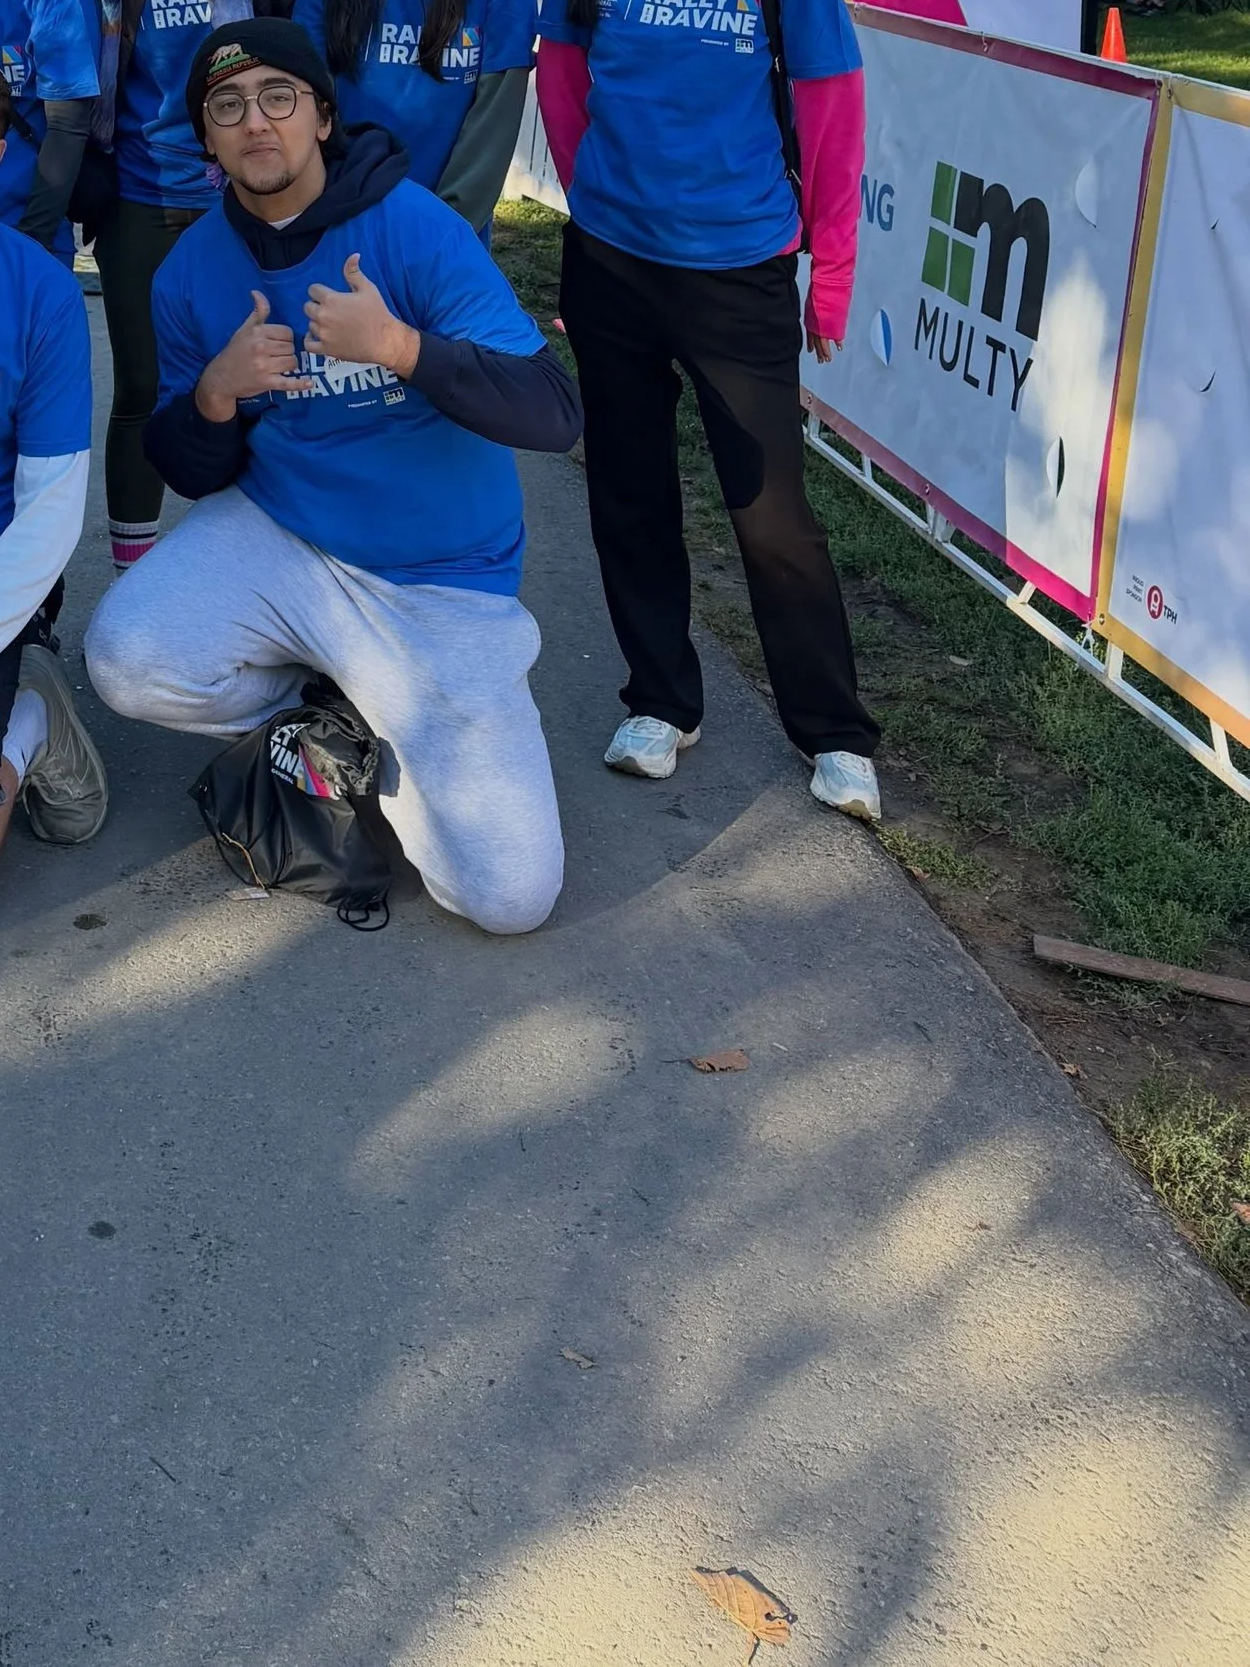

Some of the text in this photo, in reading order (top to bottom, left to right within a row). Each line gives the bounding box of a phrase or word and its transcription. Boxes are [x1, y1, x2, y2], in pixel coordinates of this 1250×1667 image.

[167, 3, 212, 27] RAV
[654, 5, 758, 36] RAVINE
[858, 173, 895, 232] NG
[914, 298, 1034, 412] MULTY
[1163, 604, 1178, 625] TPH
